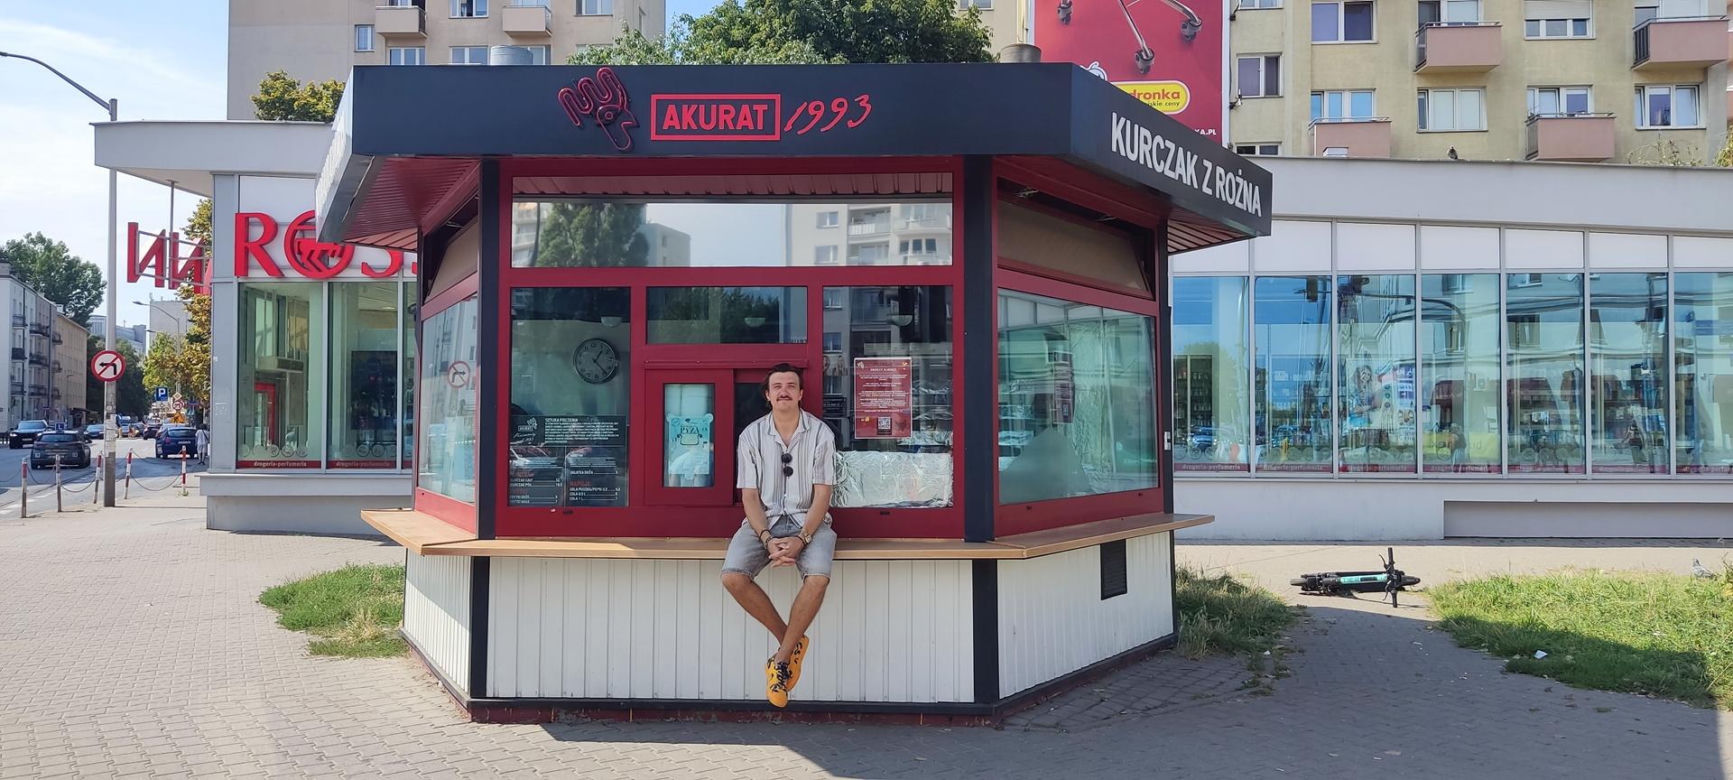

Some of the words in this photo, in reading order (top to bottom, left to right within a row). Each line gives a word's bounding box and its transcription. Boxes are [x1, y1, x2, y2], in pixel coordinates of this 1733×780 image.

[662, 104, 768, 131] AKURAT
[784, 94, 872, 135] 1993
[1111, 112, 1199, 189] KURCZAK
[1202, 159, 1213, 196] Z
[1215, 166, 1262, 218] ROŻNA
[158, 388, 166, 397] P
